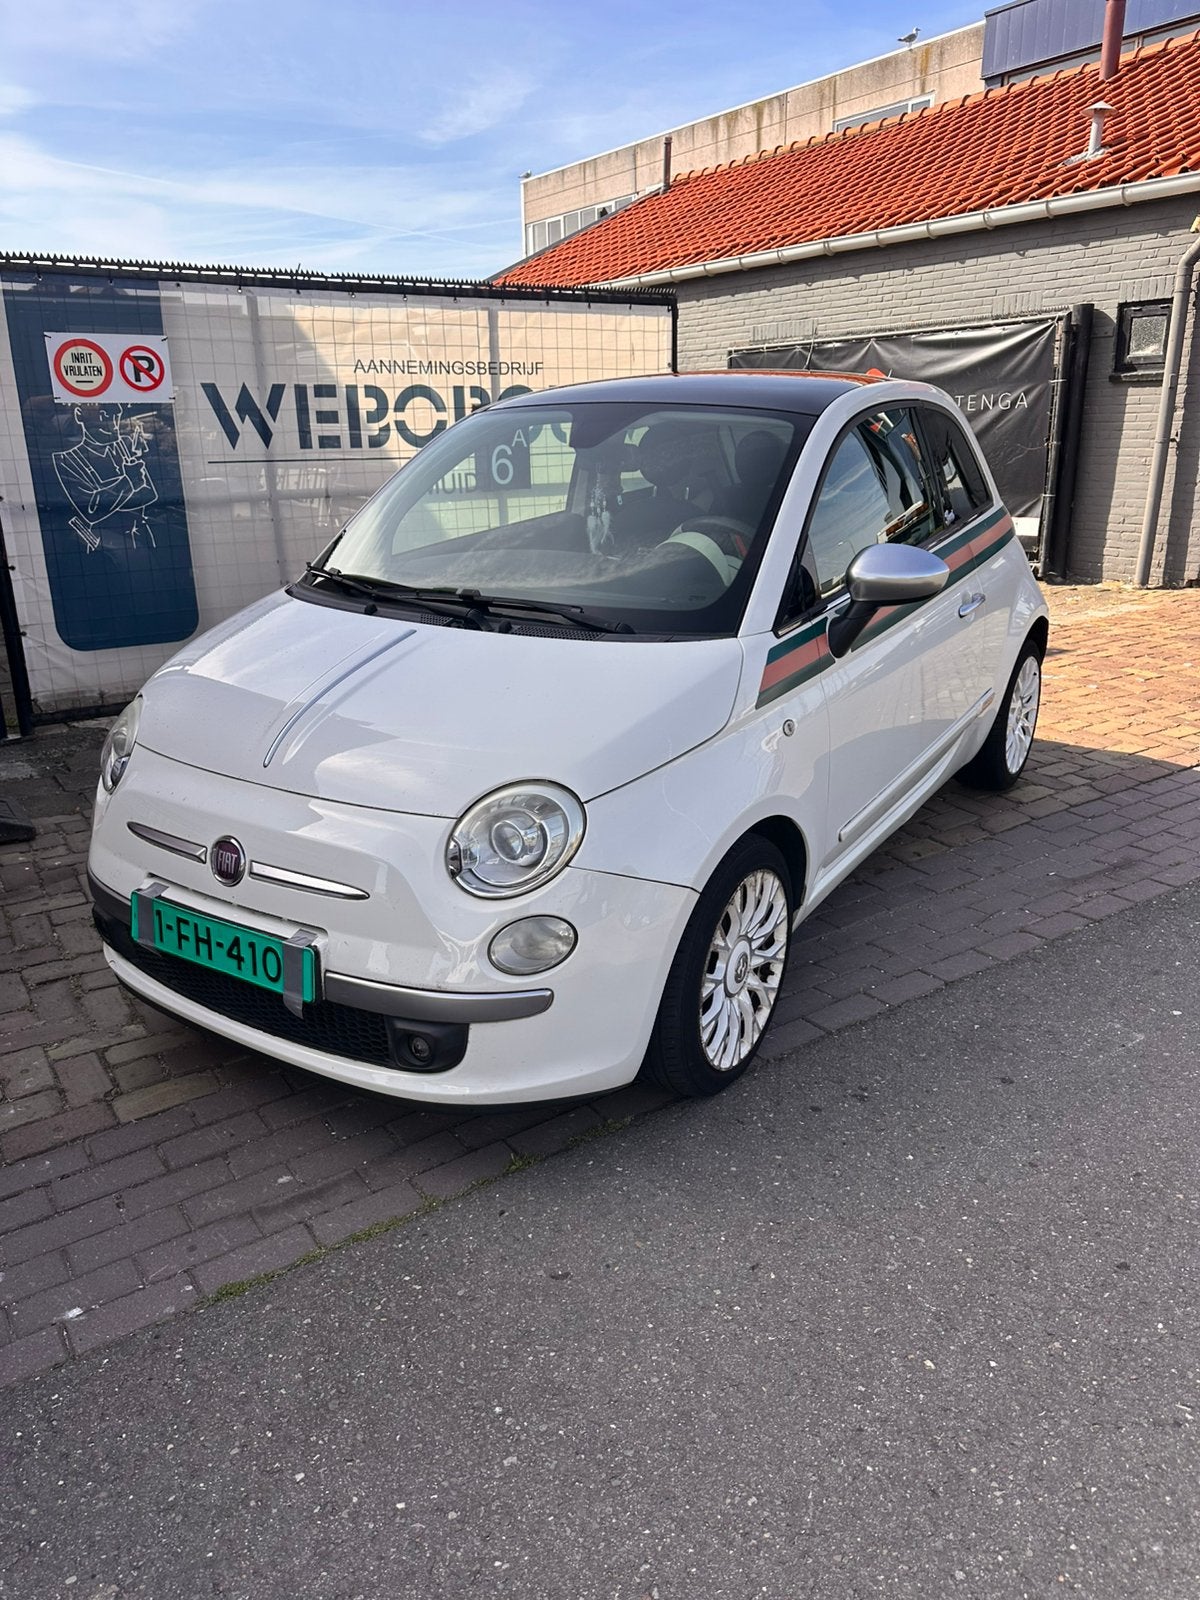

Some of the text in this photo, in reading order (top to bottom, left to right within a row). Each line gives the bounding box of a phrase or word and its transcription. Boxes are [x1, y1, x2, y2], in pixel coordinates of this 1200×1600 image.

[70, 352, 93, 364] INRIT
[63, 365, 103, 377] VRIJLATEN
[353, 359, 545, 377] AANNEMINGSBEDRIJF
[217, 850, 238, 875] FIAT
[154, 909, 282, 984] 1-FH-410
